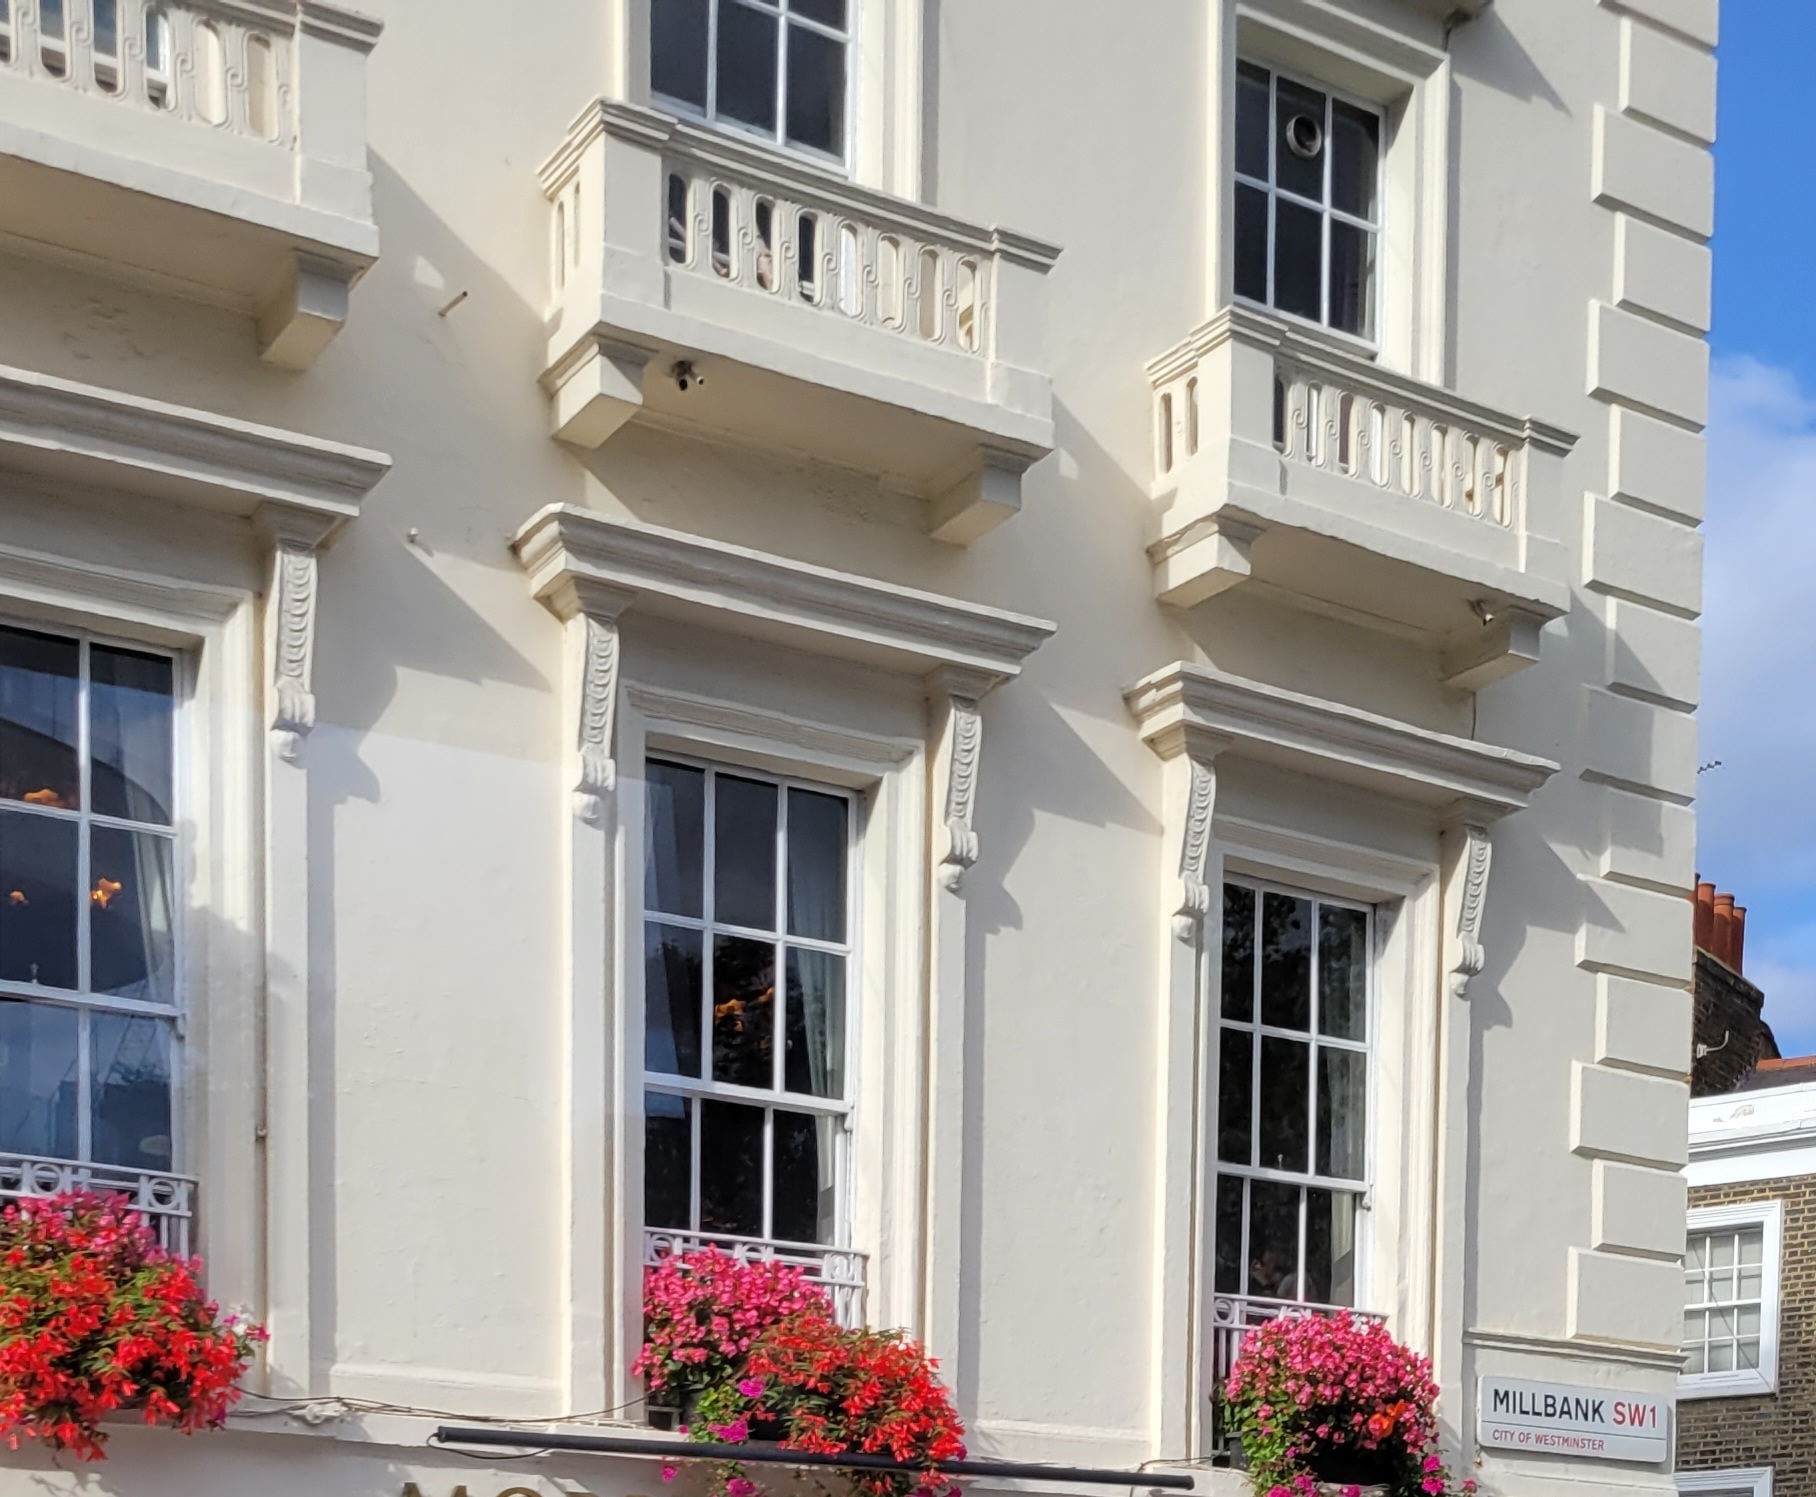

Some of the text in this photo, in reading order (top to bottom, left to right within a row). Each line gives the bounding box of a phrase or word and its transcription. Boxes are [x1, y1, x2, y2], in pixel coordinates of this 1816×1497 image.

[1493, 1388, 1657, 1428] MILLBANK SW1
[1492, 1429, 1605, 1451] CITY OF WESTMINSTER
